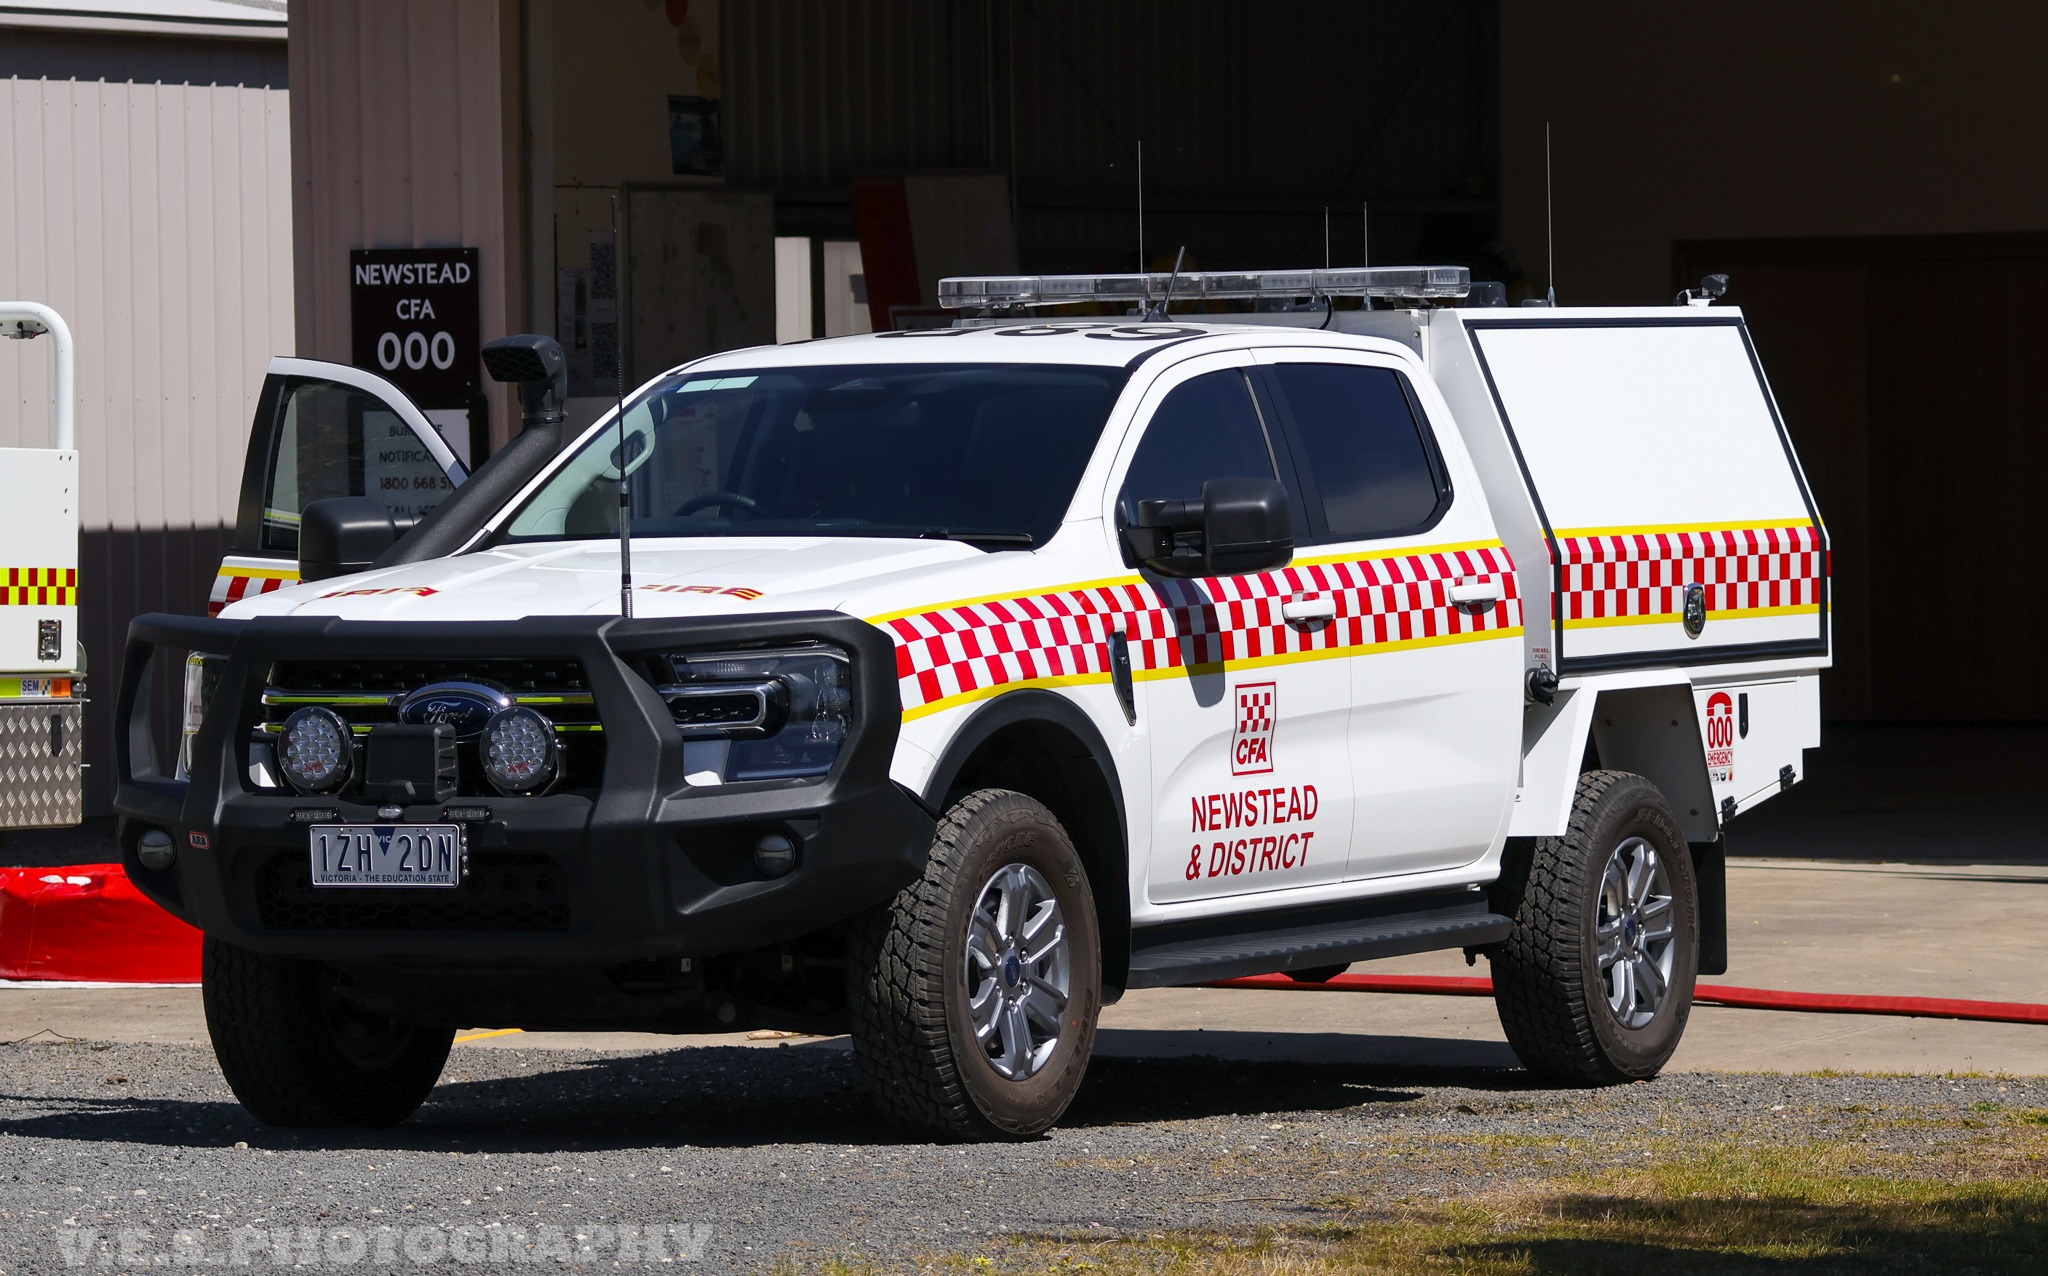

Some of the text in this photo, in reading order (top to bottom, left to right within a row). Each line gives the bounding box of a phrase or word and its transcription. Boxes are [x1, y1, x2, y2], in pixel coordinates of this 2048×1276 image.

[355, 262, 471, 285] NEWSTEAD
[395, 298, 436, 320] CFA
[377, 330, 456, 371] 000
[389, 426, 414, 437] BUR
[379, 450, 436, 462] NOTIFICA
[380, 477, 409, 490] 1800
[413, 477, 436, 490] 668
[22, 679, 39, 692] SEM
[1707, 715, 1733, 749] 000
[1236, 737, 1268, 765] CFA
[1707, 750, 1733, 766] EMERGENCY
[1191, 784, 1319, 833] NEWSTEAD
[378, 835, 392, 844] VIC
[319, 834, 453, 872] 1ZH 2DN
[1185, 831, 1315, 881] & DISTRICT
[320, 874, 357, 882] VICTORIA
[364, 874, 380, 882] THE
[382, 874, 426, 883] EDUCATION
[428, 874, 450, 883] STATE
